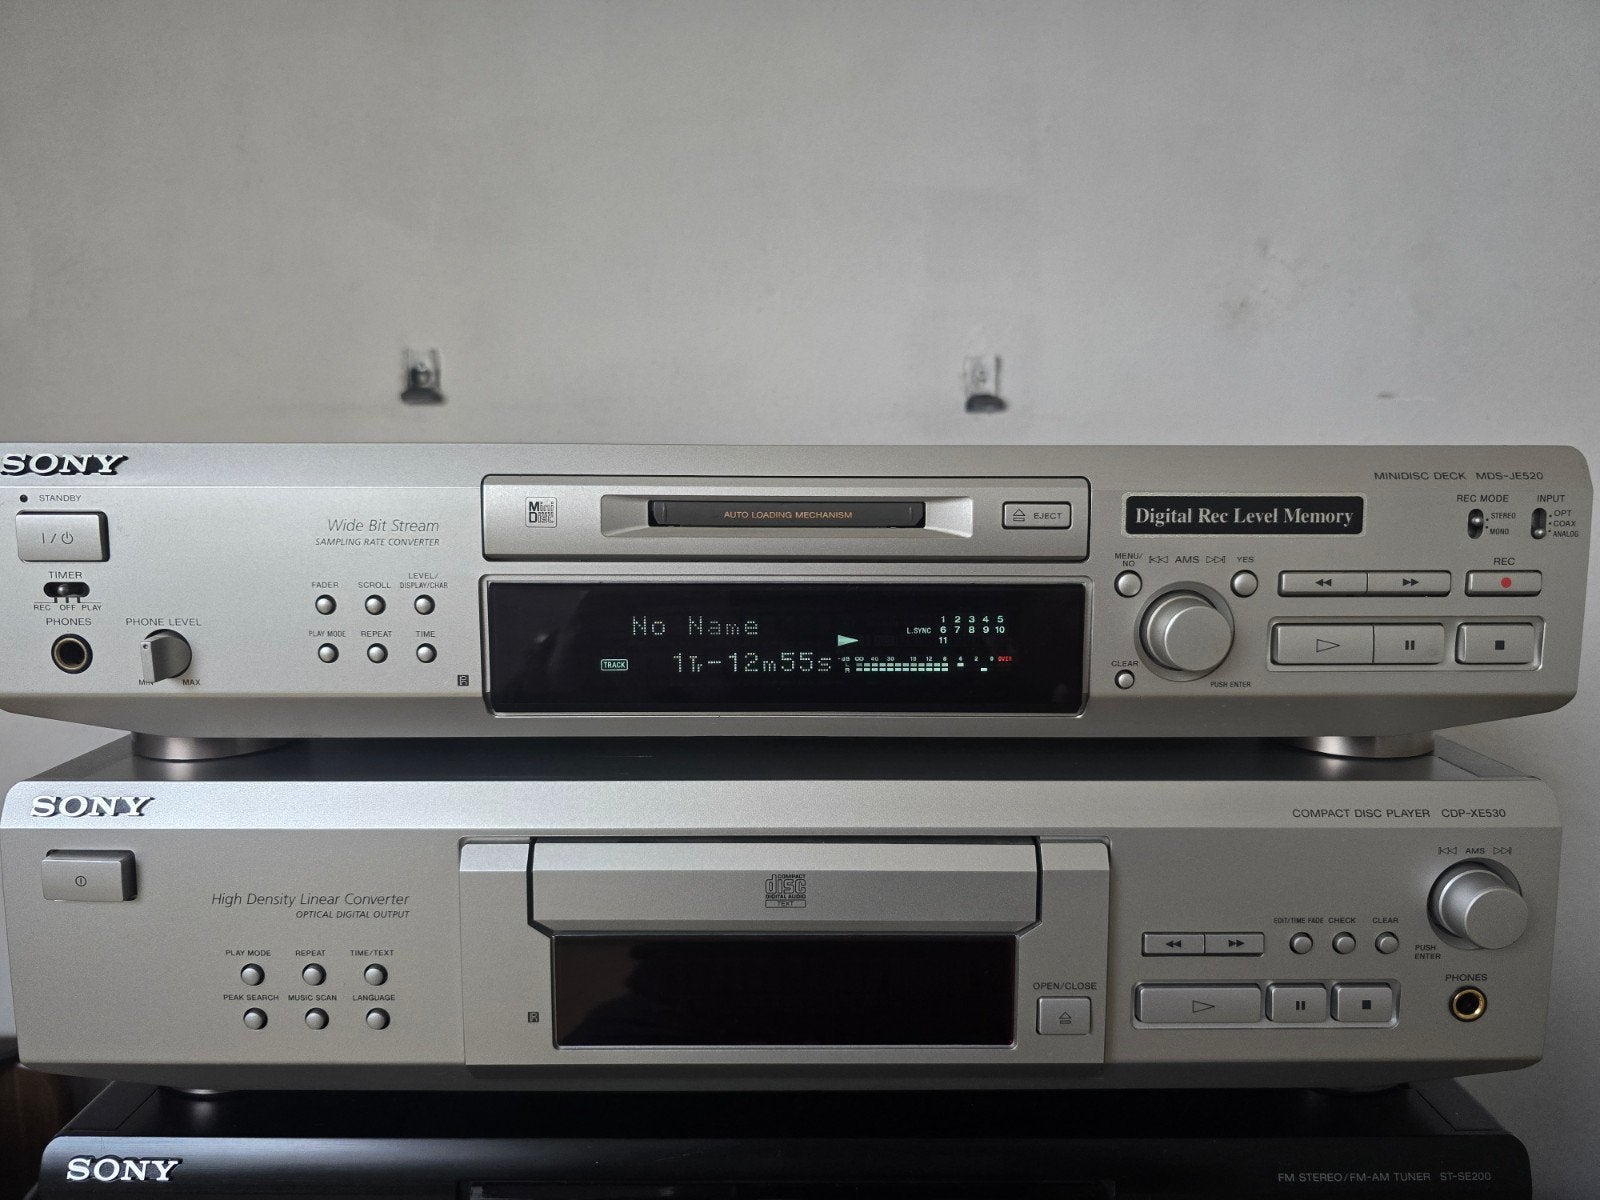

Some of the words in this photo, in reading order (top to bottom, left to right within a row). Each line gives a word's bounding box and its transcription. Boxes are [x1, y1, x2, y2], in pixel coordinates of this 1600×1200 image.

[0, 453, 126, 475] SONY
[1374, 472, 1429, 480] MINIDISC
[1434, 472, 1467, 480] DECK
[1476, 472, 1544, 480] MDS-JE520
[39, 494, 81, 502] STANDBY
[1456, 495, 1477, 503] REC
[1480, 495, 1509, 503] MODE
[1537, 495, 1565, 503] INPUT
[724, 511, 749, 519] AUTO
[751, 511, 793, 519] LOADING
[795, 511, 853, 519] MECHANISM
[1033, 512, 1062, 520] EJECT
[1135, 507, 1192, 528] Digital
[1199, 508, 1229, 524] Rec
[1233, 507, 1278, 524] Level
[1283, 507, 1354, 528] Memory
[328, 518, 364, 532] Wide
[368, 518, 387, 532] Bit
[391, 518, 440, 532] Stream
[315, 538, 361, 546] SAMPLING
[363, 538, 385, 546] RATE
[388, 538, 440, 546] CONVERTER
[1175, 556, 1200, 564] AMS
[1493, 557, 1516, 566] REC
[48, 571, 83, 580] TIMER
[46, 617, 92, 627] PHONES
[126, 617, 165, 627] PHONE
[169, 617, 202, 627] LEVEL
[632, 615, 666, 635] No
[688, 615, 759, 635] Name
[940, 626, 947, 634] 6
[954, 626, 961, 634] 7
[968, 626, 975, 634] 8
[982, 626, 990, 634] 9
[995, 626, 1005, 634] 10
[603, 661, 626, 669] TRACK
[31, 796, 153, 817] SONY
[1292, 808, 1350, 818] COMPACT
[1354, 808, 1382, 818] DISC
[1386, 808, 1431, 818] PLAYER
[1441, 808, 1506, 818] CDP-XE530
[211, 892, 242, 908] High
[247, 892, 296, 908] Density
[300, 892, 341, 905] Linear
[345, 892, 410, 905] Converter
[295, 910, 334, 919] OPTICAL
[336, 910, 371, 919] DIGITAL
[373, 910, 410, 919] OUTPUT
[1445, 973, 1488, 982] PHONES
[1032, 982, 1097, 990] OPEN/CLOSE
[66, 1156, 181, 1181] SONY
[1277, 1172, 1295, 1182] FM
[1298, 1172, 1390, 1182] STEREO/FM-AM
[1394, 1172, 1431, 1181] TUNER
[1440, 1172, 1492, 1181] ST-SE200
